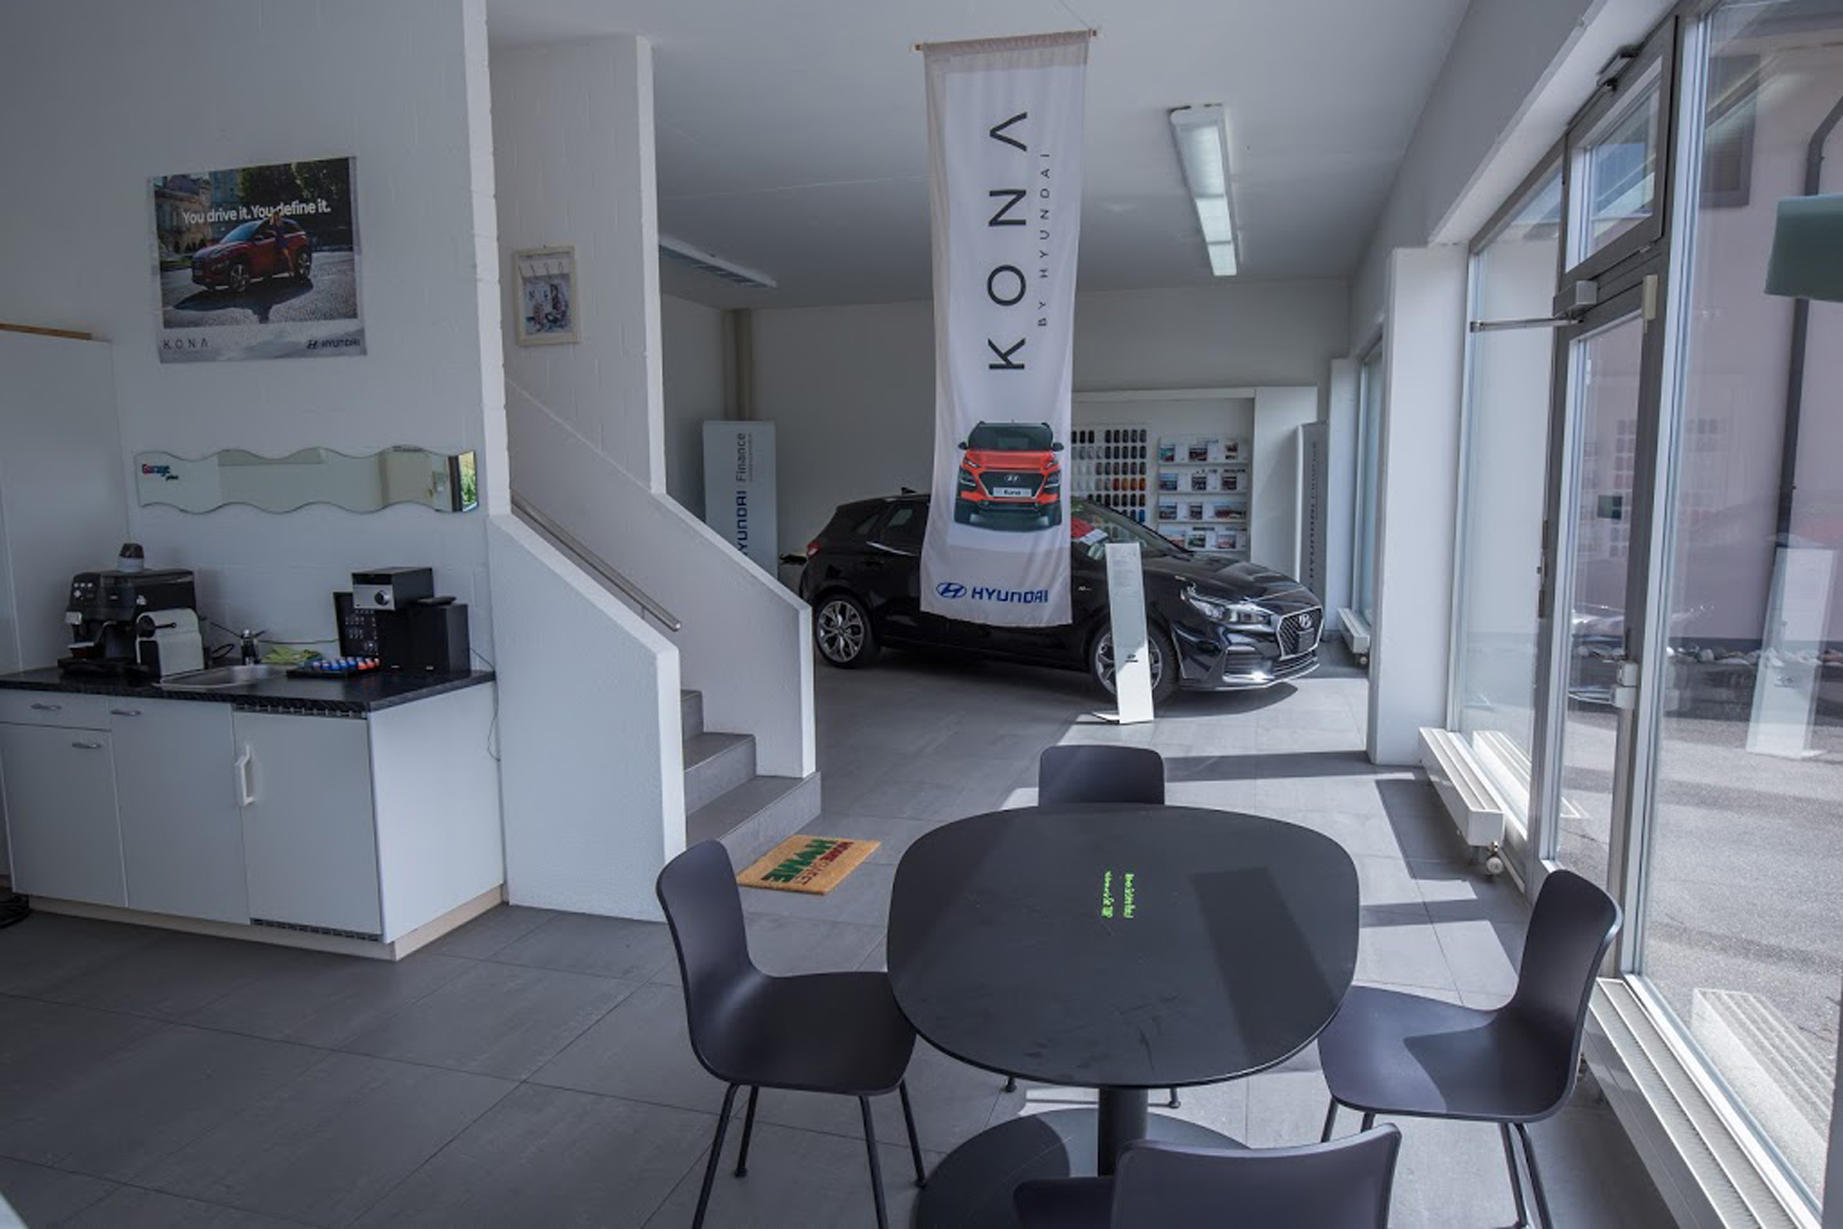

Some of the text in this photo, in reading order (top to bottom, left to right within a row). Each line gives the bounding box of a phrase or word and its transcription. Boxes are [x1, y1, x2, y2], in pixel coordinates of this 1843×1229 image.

[183, 198, 331, 224] You drive it. You define it.
[1037, 152, 1051, 327] BY HYUNDAI
[321, 338, 361, 349] HYUNDAI
[735, 433, 747, 483] Finance
[971, 585, 1049, 604] HYUNDAI
